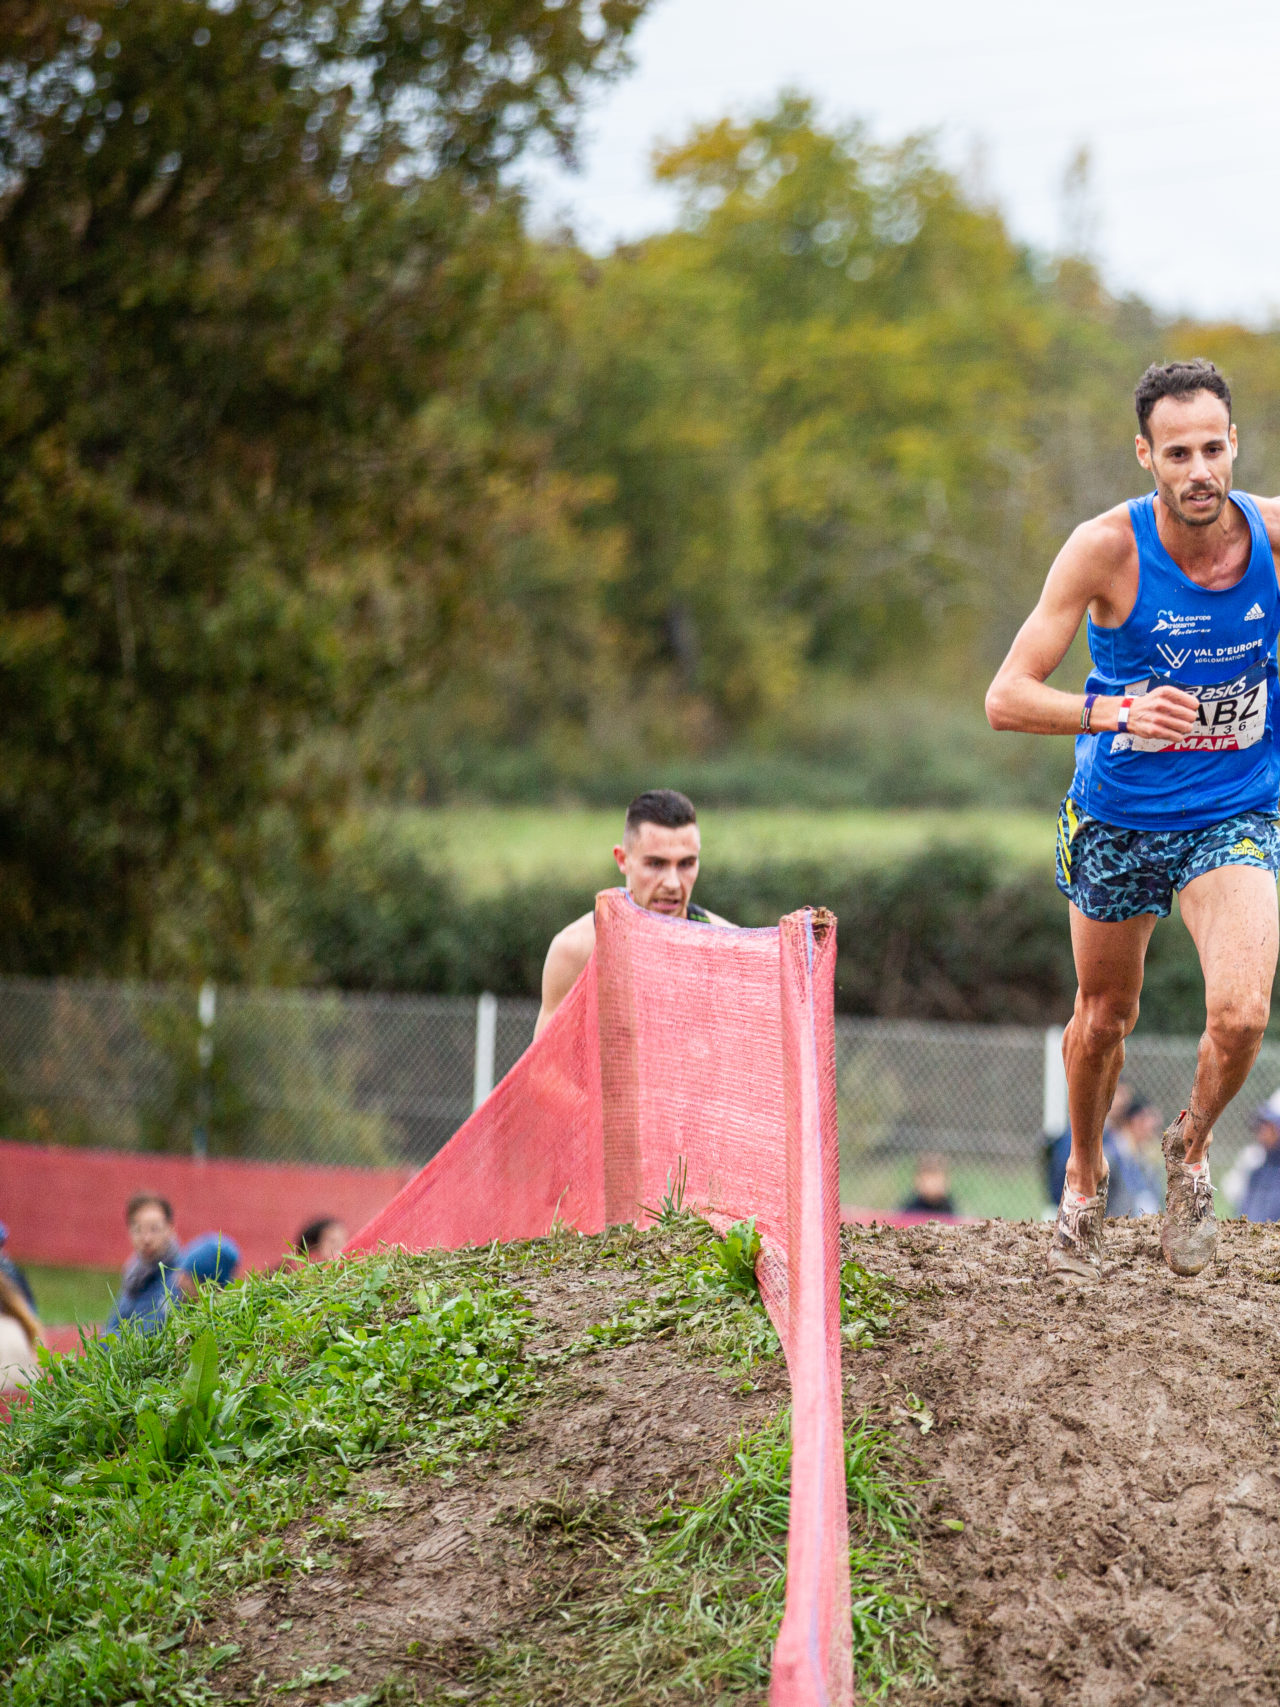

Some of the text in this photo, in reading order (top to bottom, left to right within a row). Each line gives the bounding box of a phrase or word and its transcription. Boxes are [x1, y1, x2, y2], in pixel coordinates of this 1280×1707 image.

[1194, 638, 1263, 657] VAL D'EUROPE
[1200, 675, 1246, 700] asics
[1174, 735, 1236, 750] MAIF
[1229, 847, 1264, 860] adidas
